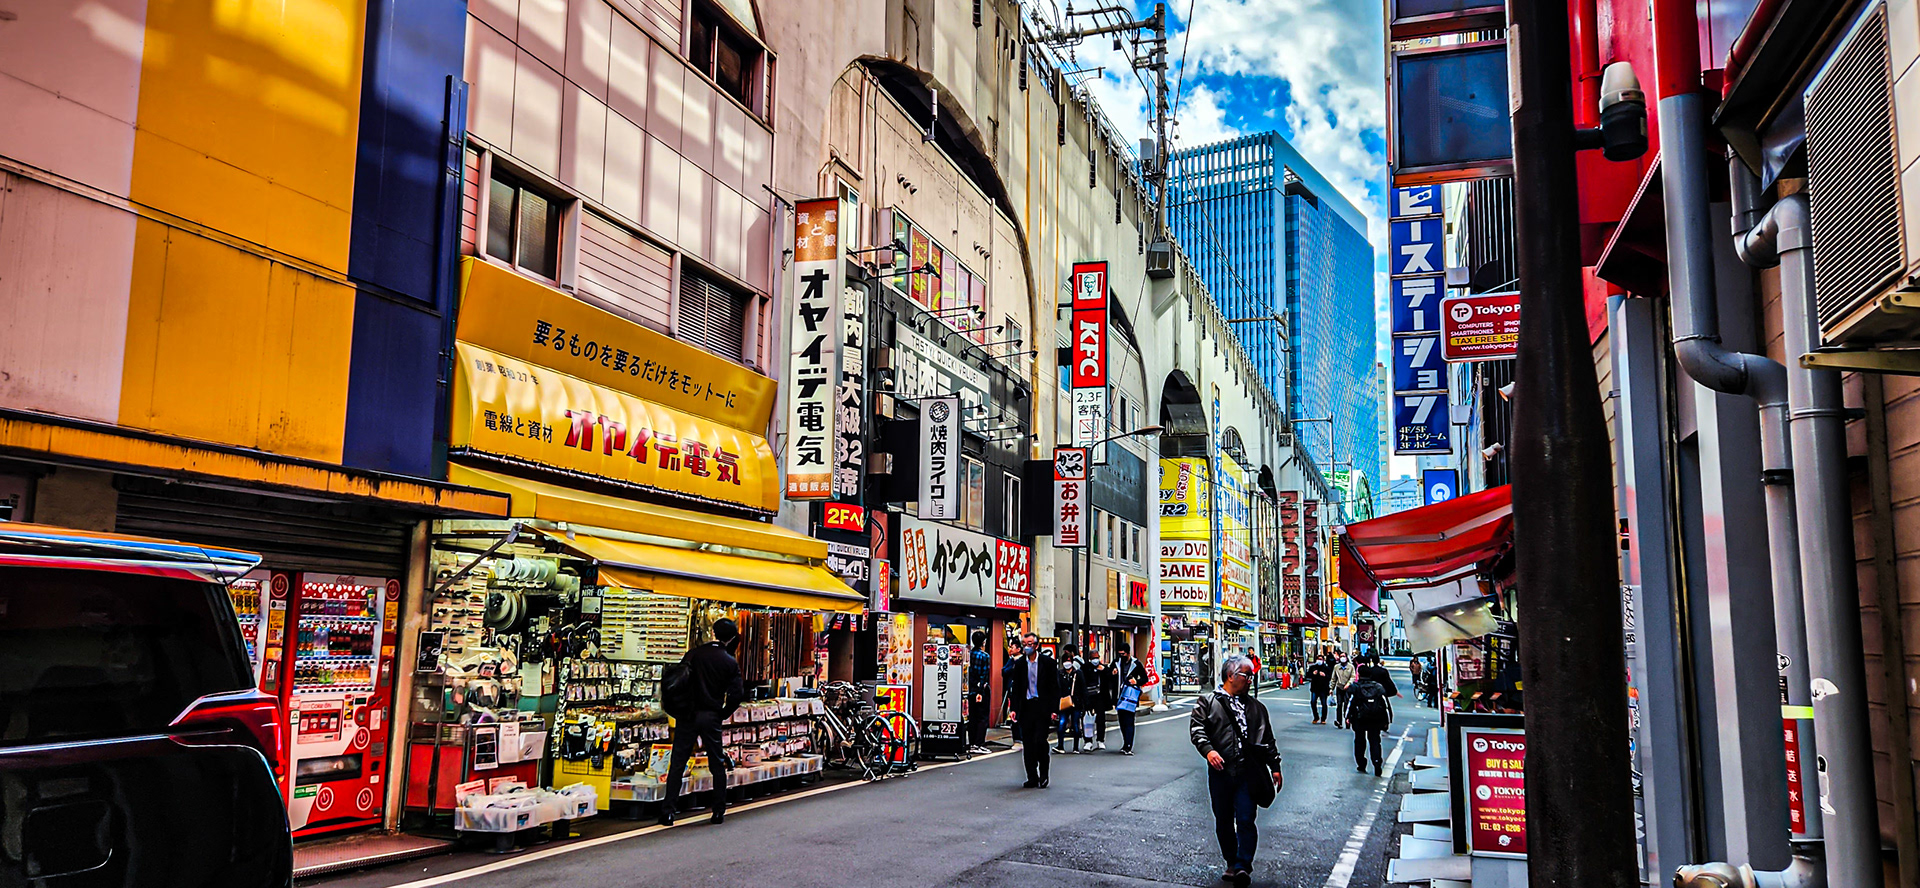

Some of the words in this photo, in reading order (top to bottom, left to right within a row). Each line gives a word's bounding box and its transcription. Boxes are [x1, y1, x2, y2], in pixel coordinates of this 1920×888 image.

[796, 212, 810, 249] 資材
[811, 224, 826, 236] と
[824, 209, 837, 248] 電線
[1399, 186, 1438, 424] ビーステーション
[1455, 307, 1469, 318] TP
[1475, 304, 1513, 315] Tokyo
[1450, 328, 1495, 337] SMARTPHONES
[1458, 321, 1494, 329] COMPUTERS
[1079, 319, 1100, 377] KFC
[1455, 337, 1473, 345] TAX
[1475, 335, 1498, 343] FREE
[1461, 342, 1518, 351] www.tokyopc.j
[532, 319, 737, 409] 要るものを要るだけをモットーに
[796, 268, 830, 467] オヤイデ電気
[484, 409, 553, 444] 電線と資材
[1400, 432, 1447, 442] カードゲーム
[564, 409, 741, 486] オヤイデ電気
[1400, 441, 1411, 449] 3F
[1413, 441, 1438, 449] ホビー
[788, 481, 830, 492] 通信販売
[1060, 482, 1080, 545] お弁当
[904, 532, 916, 582] とんかつ
[931, 528, 993, 596] かつや
[999, 541, 1028, 571] カツ丼
[998, 567, 1028, 592] とんかつ
[1160, 563, 1206, 578] GAME
[1132, 581, 1148, 607] KFC
[941, 722, 957, 735] 2F
[1489, 740, 1525, 752] Tokyo
[1486, 758, 1501, 769] BUY
[1509, 759, 1524, 770] SAL
